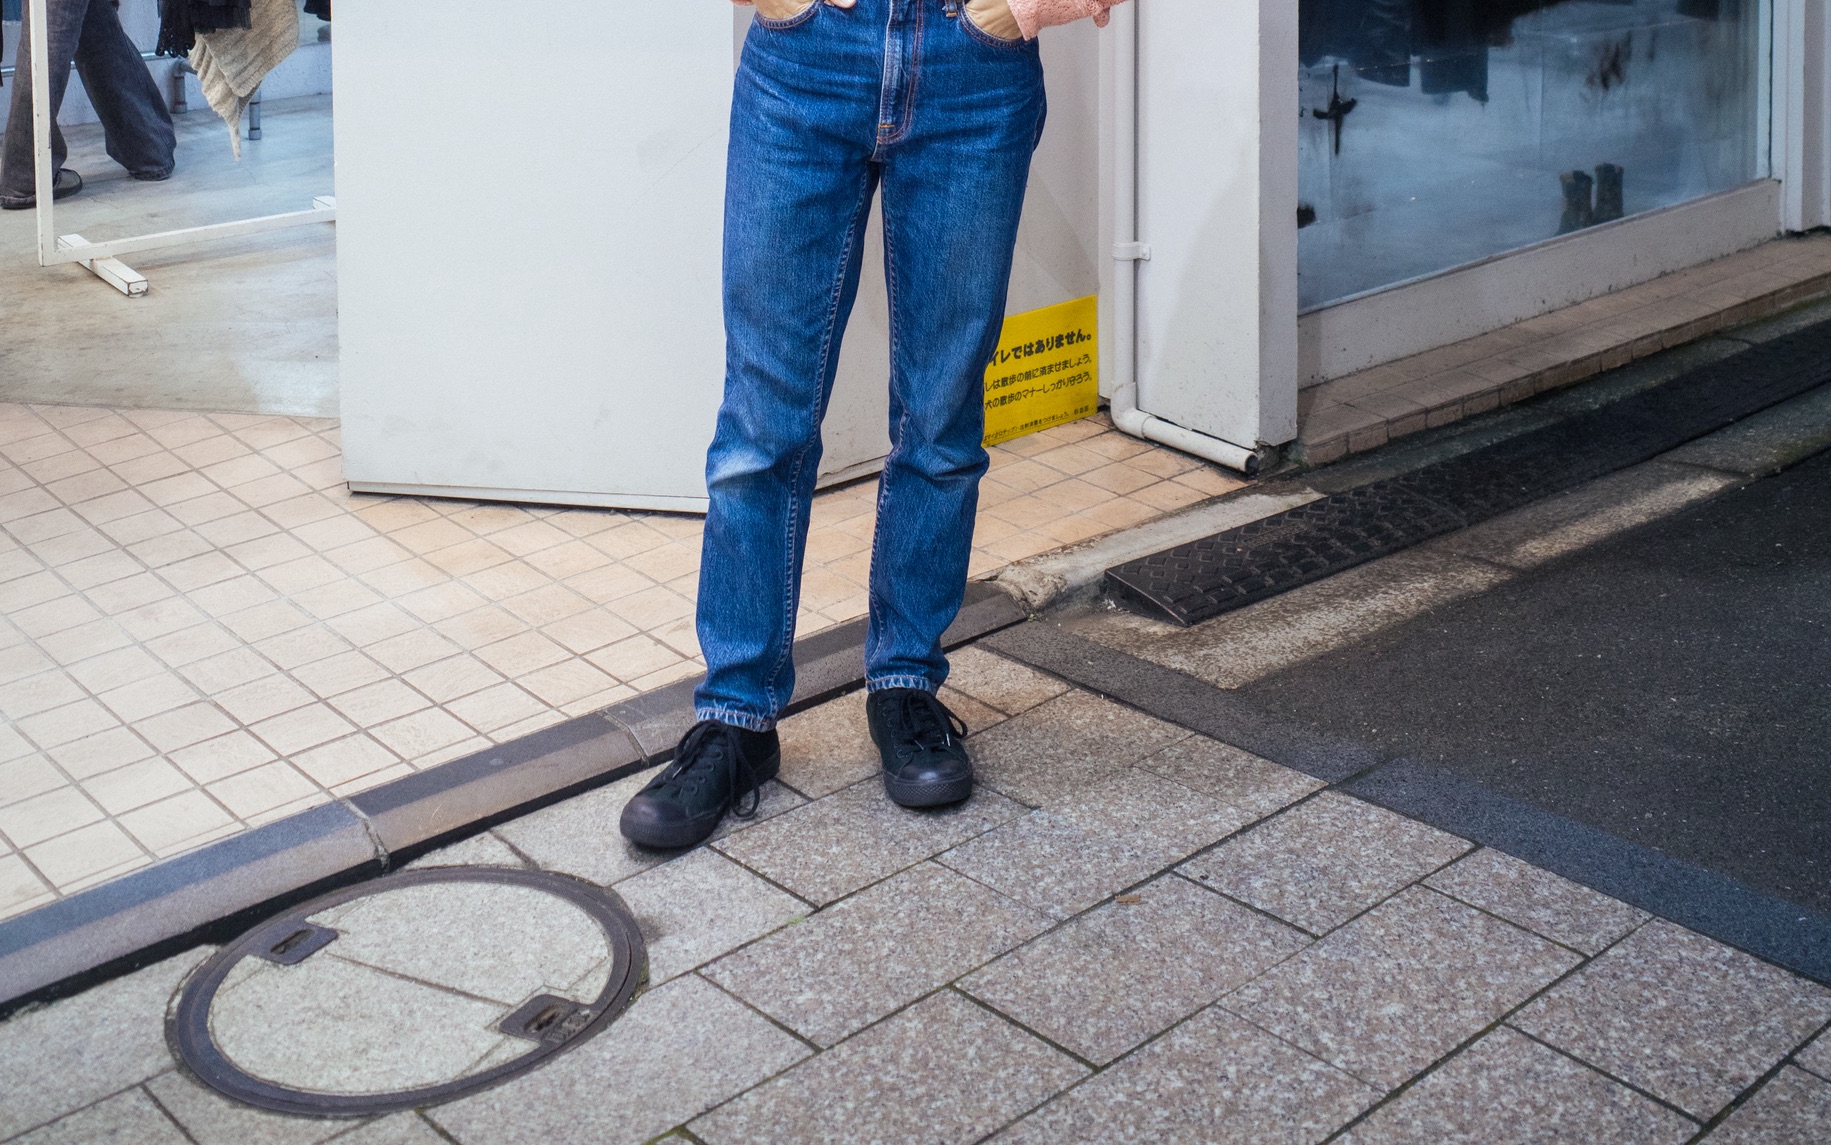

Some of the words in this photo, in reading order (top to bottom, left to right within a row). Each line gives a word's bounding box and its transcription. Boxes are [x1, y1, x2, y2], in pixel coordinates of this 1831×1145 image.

[990, 329, 1092, 366] イレではありません。
